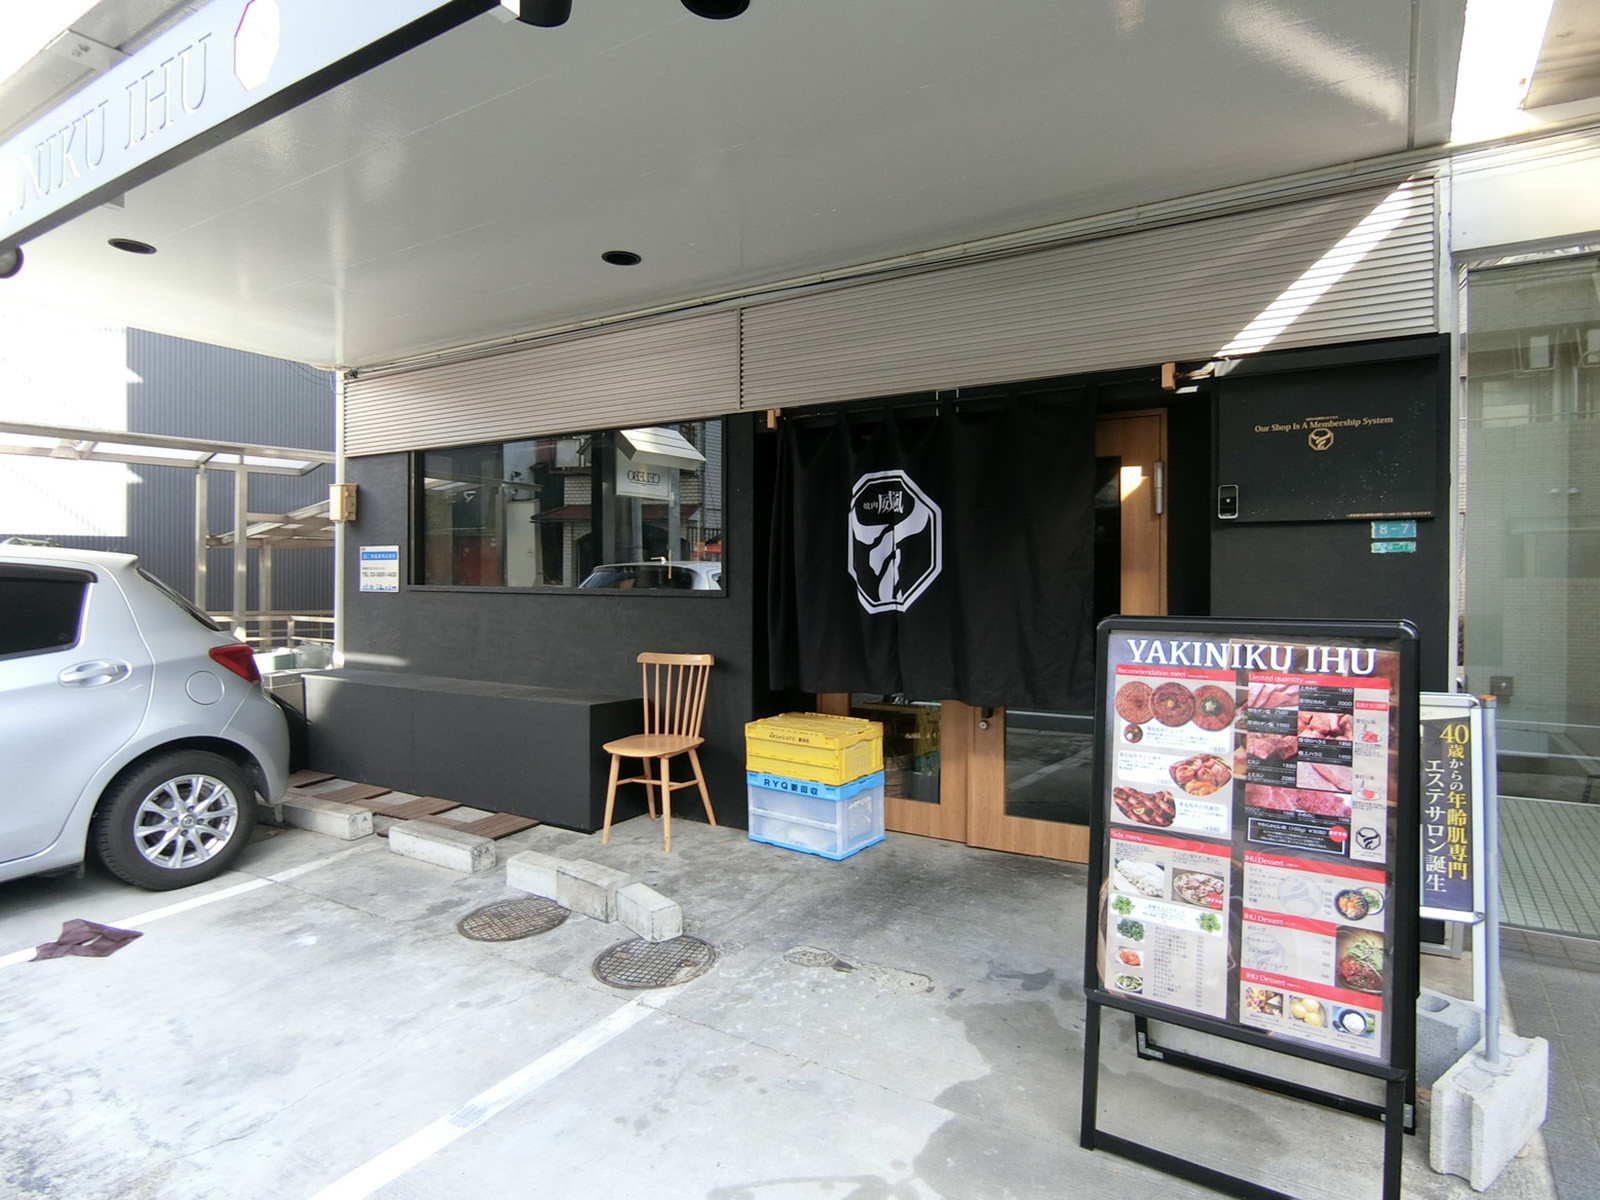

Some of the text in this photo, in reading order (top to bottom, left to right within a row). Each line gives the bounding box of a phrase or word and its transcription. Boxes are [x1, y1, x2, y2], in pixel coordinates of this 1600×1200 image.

[9, 31, 213, 216] NIKU IHU
[1254, 424, 1270, 433] Our
[1271, 422, 1292, 432] Shop
[1292, 422, 1300, 430] Is
[1301, 421, 1308, 429] A
[1309, 418, 1362, 428] Membership
[1362, 416, 1394, 426] System
[1127, 639, 1377, 675] YAKINIKU IHU
[1117, 667, 1169, 676] Recommendation
[1248, 674, 1274, 682] Limited
[764, 779, 818, 795] RYQ要回収
[1424, 759, 1447, 893] エステサロン誕生
[1258, 857, 1284, 866] Dessert
[1258, 917, 1284, 925] Dessert
[1260, 974, 1286, 986] Dessert
